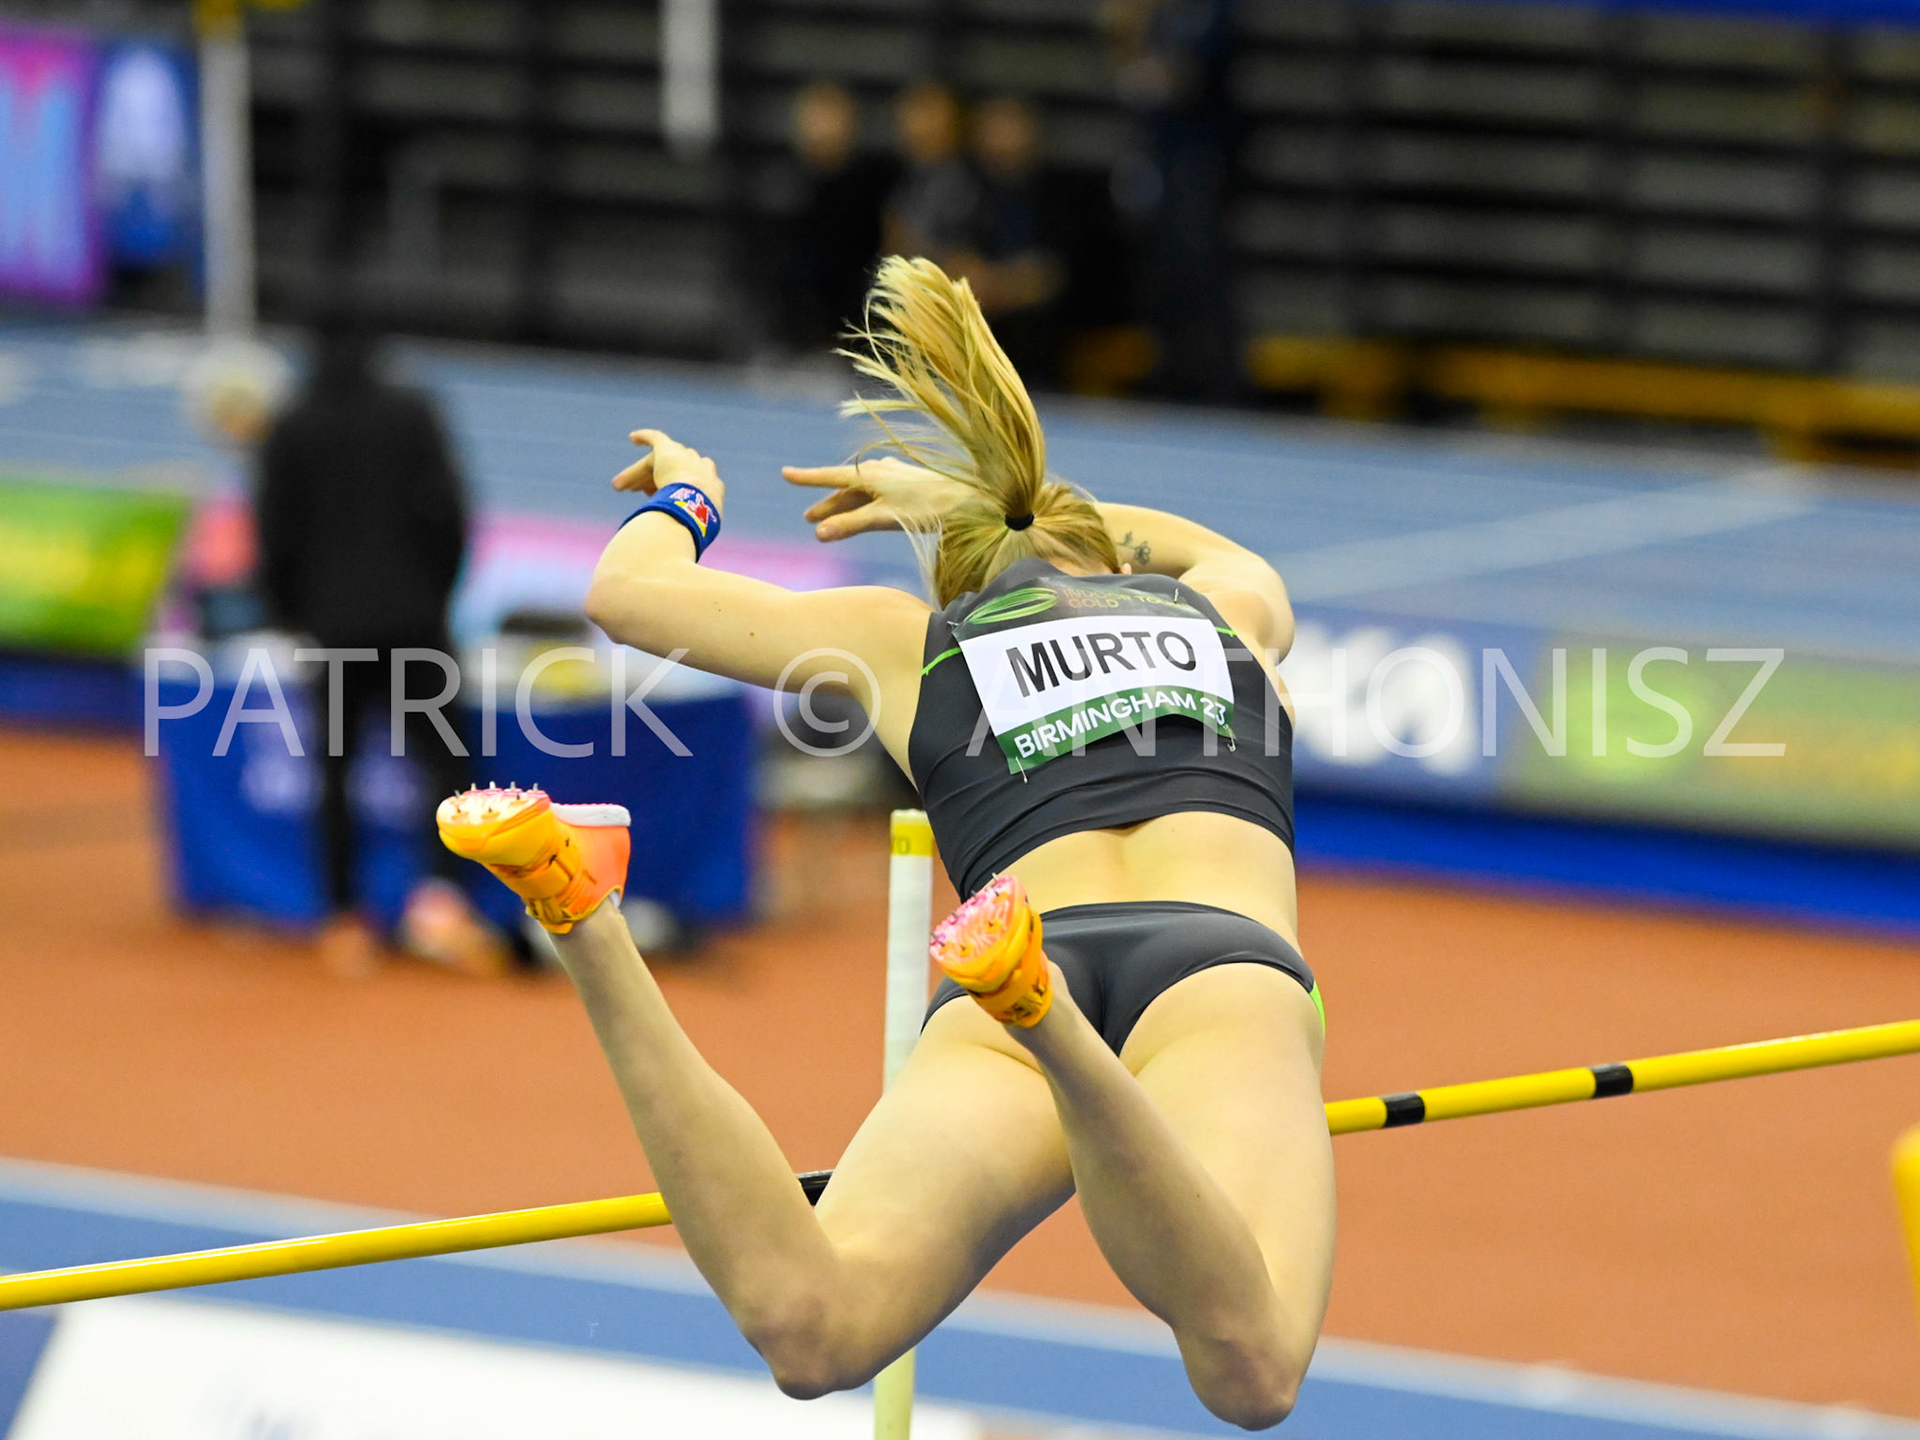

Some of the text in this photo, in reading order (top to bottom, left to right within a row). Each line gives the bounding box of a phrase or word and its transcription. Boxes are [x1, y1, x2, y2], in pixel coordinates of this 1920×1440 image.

[1068, 598, 1120, 609] GOLD
[1005, 631, 1197, 698] MURTO
[1014, 690, 1227, 759] BIRMINGHAM 23
